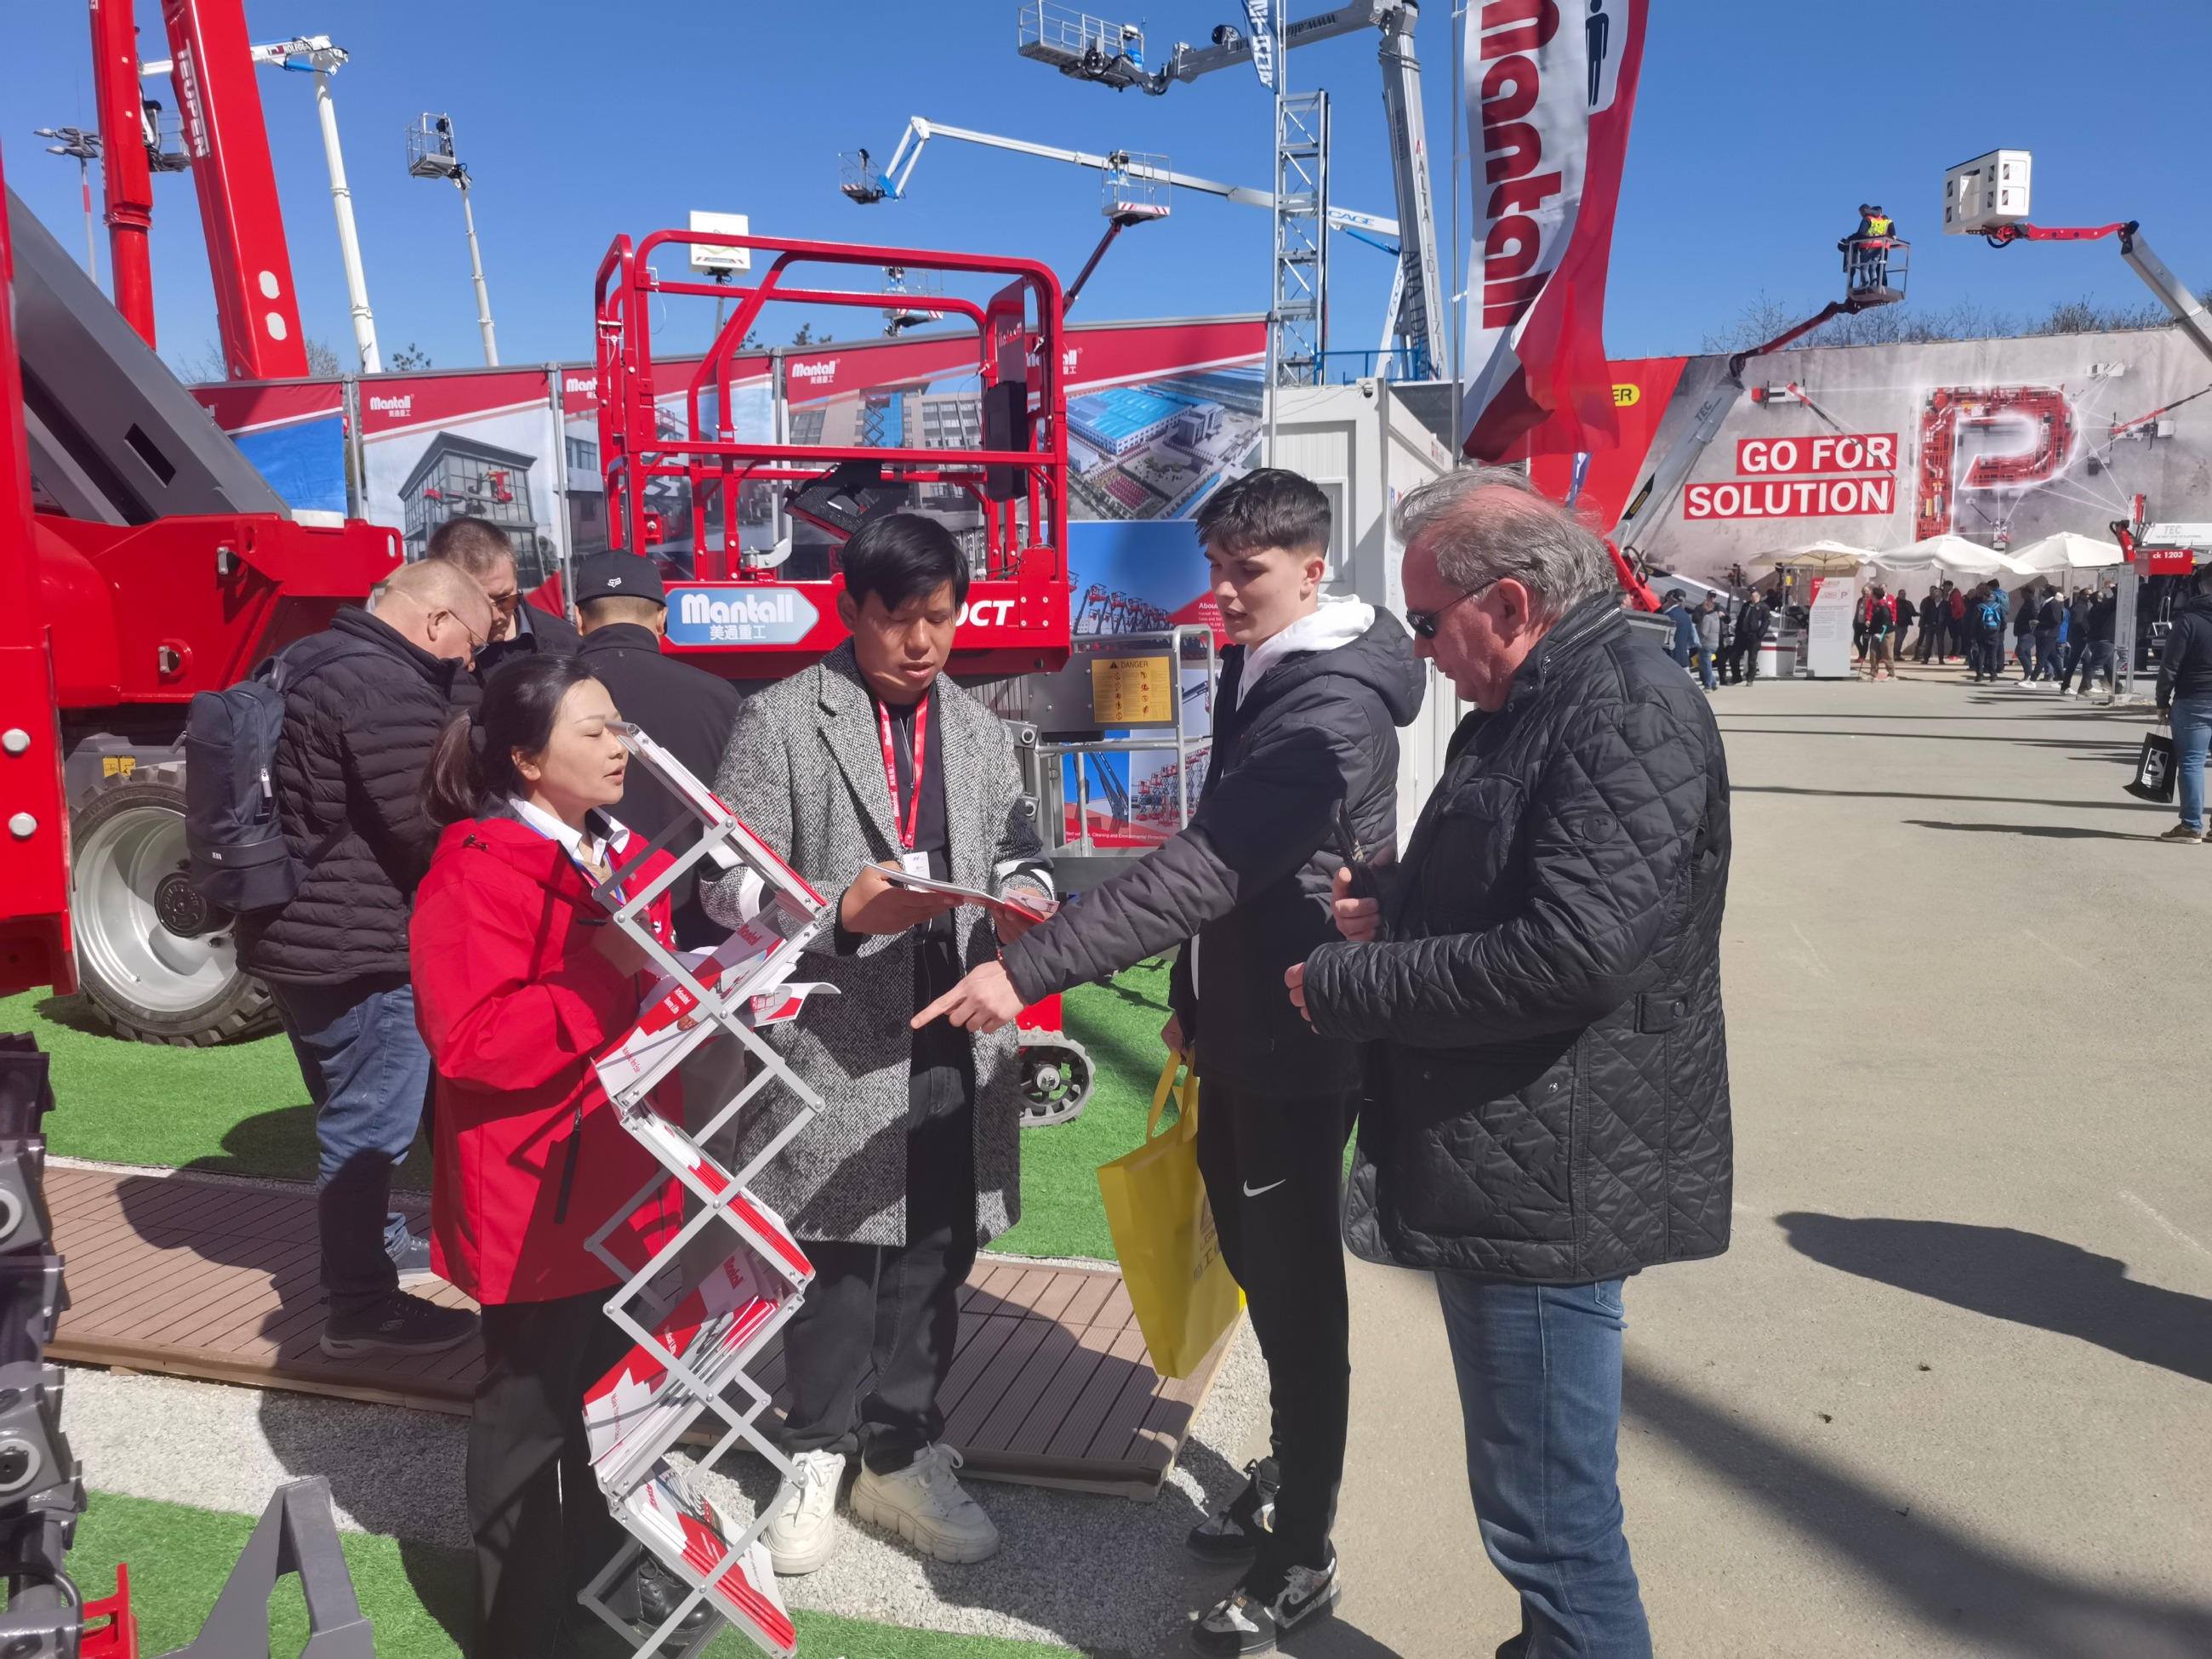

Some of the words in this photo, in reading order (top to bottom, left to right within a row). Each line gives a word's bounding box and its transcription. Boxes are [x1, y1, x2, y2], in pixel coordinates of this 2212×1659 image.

[177, 38, 211, 158] TEUPEN
[1417, 162, 1430, 224] ALTA
[791, 361, 836, 377] Mantall
[370, 396, 411, 410] Mantall
[1695, 401, 1713, 422] TEC
[1742, 440, 1798, 472] GO
[1812, 436, 1892, 470] FOR
[1688, 481, 1890, 517] SOLUTION
[2164, 525, 2182, 535] TEC
[681, 593, 794, 624] Mantall
[710, 624, 766, 641] 美通重工
